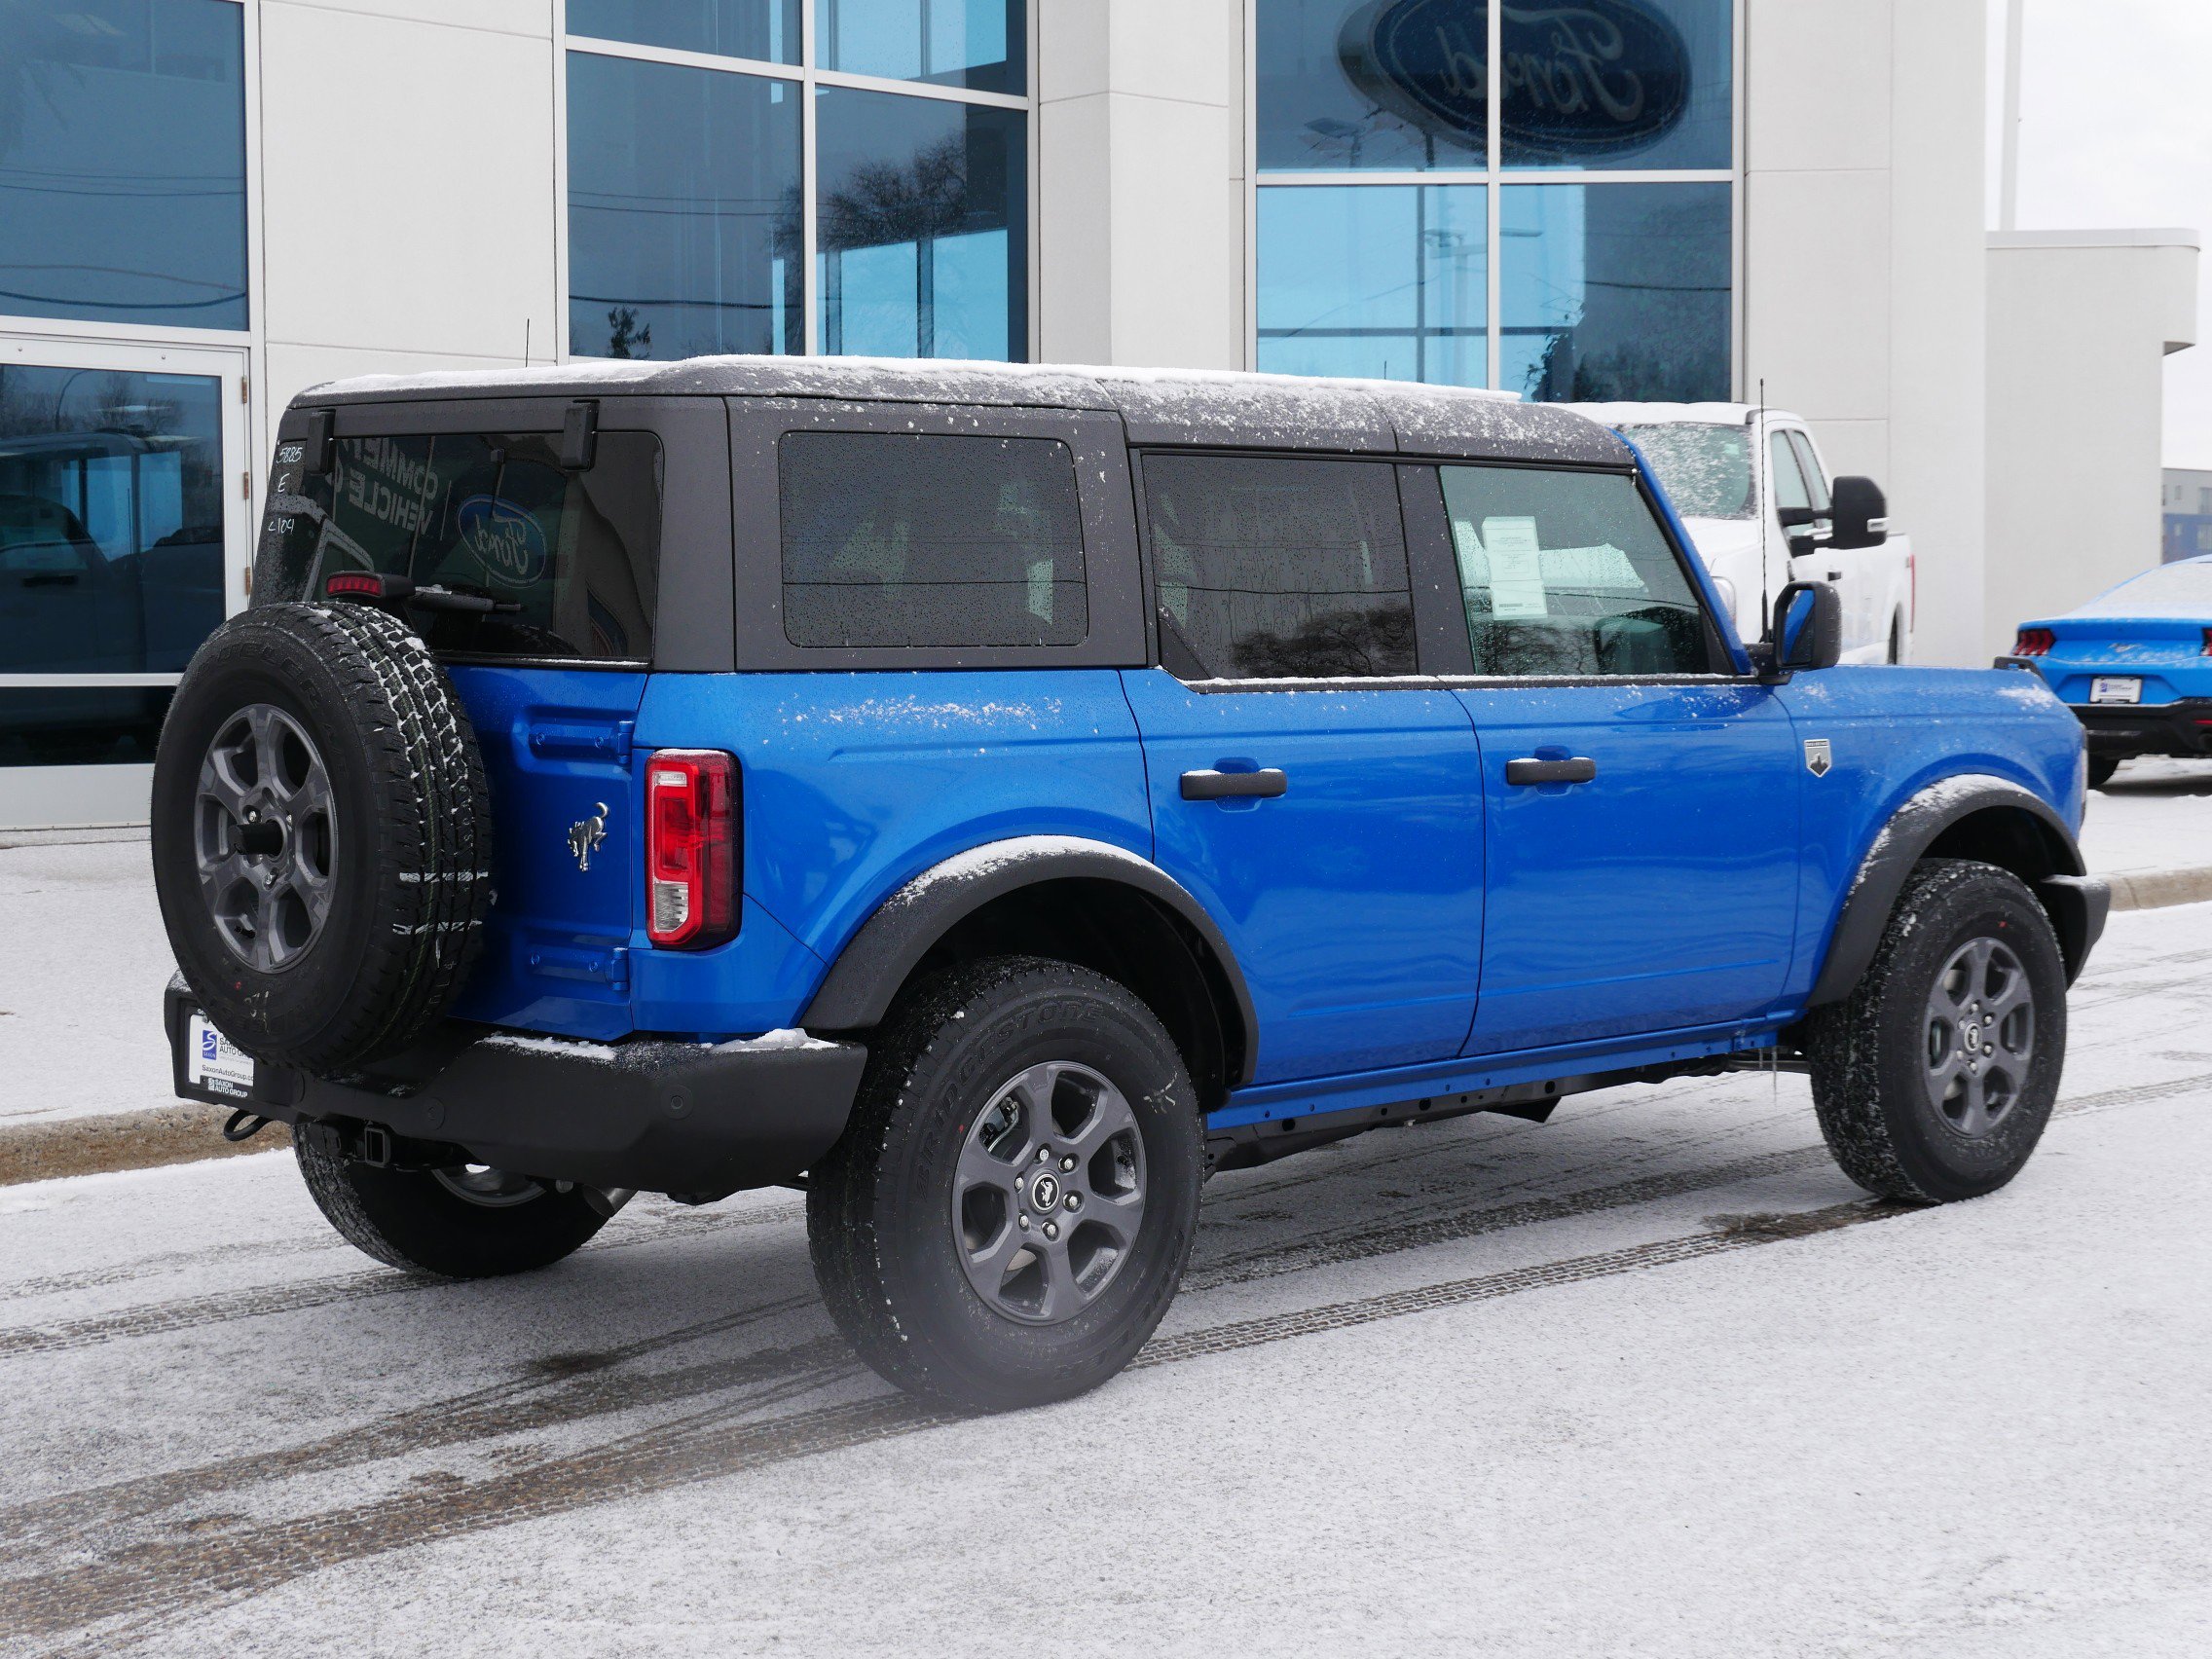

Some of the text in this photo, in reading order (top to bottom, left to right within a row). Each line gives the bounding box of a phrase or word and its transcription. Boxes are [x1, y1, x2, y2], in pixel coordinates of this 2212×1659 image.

[277, 472, 290, 493] E
[219, 1046, 237, 1055] AUTO
[214, 1078, 234, 1088] SAXON
[214, 1085, 248, 1098] AUTO GROUP
[914, 999, 1105, 1201] BRIDGESTONE
